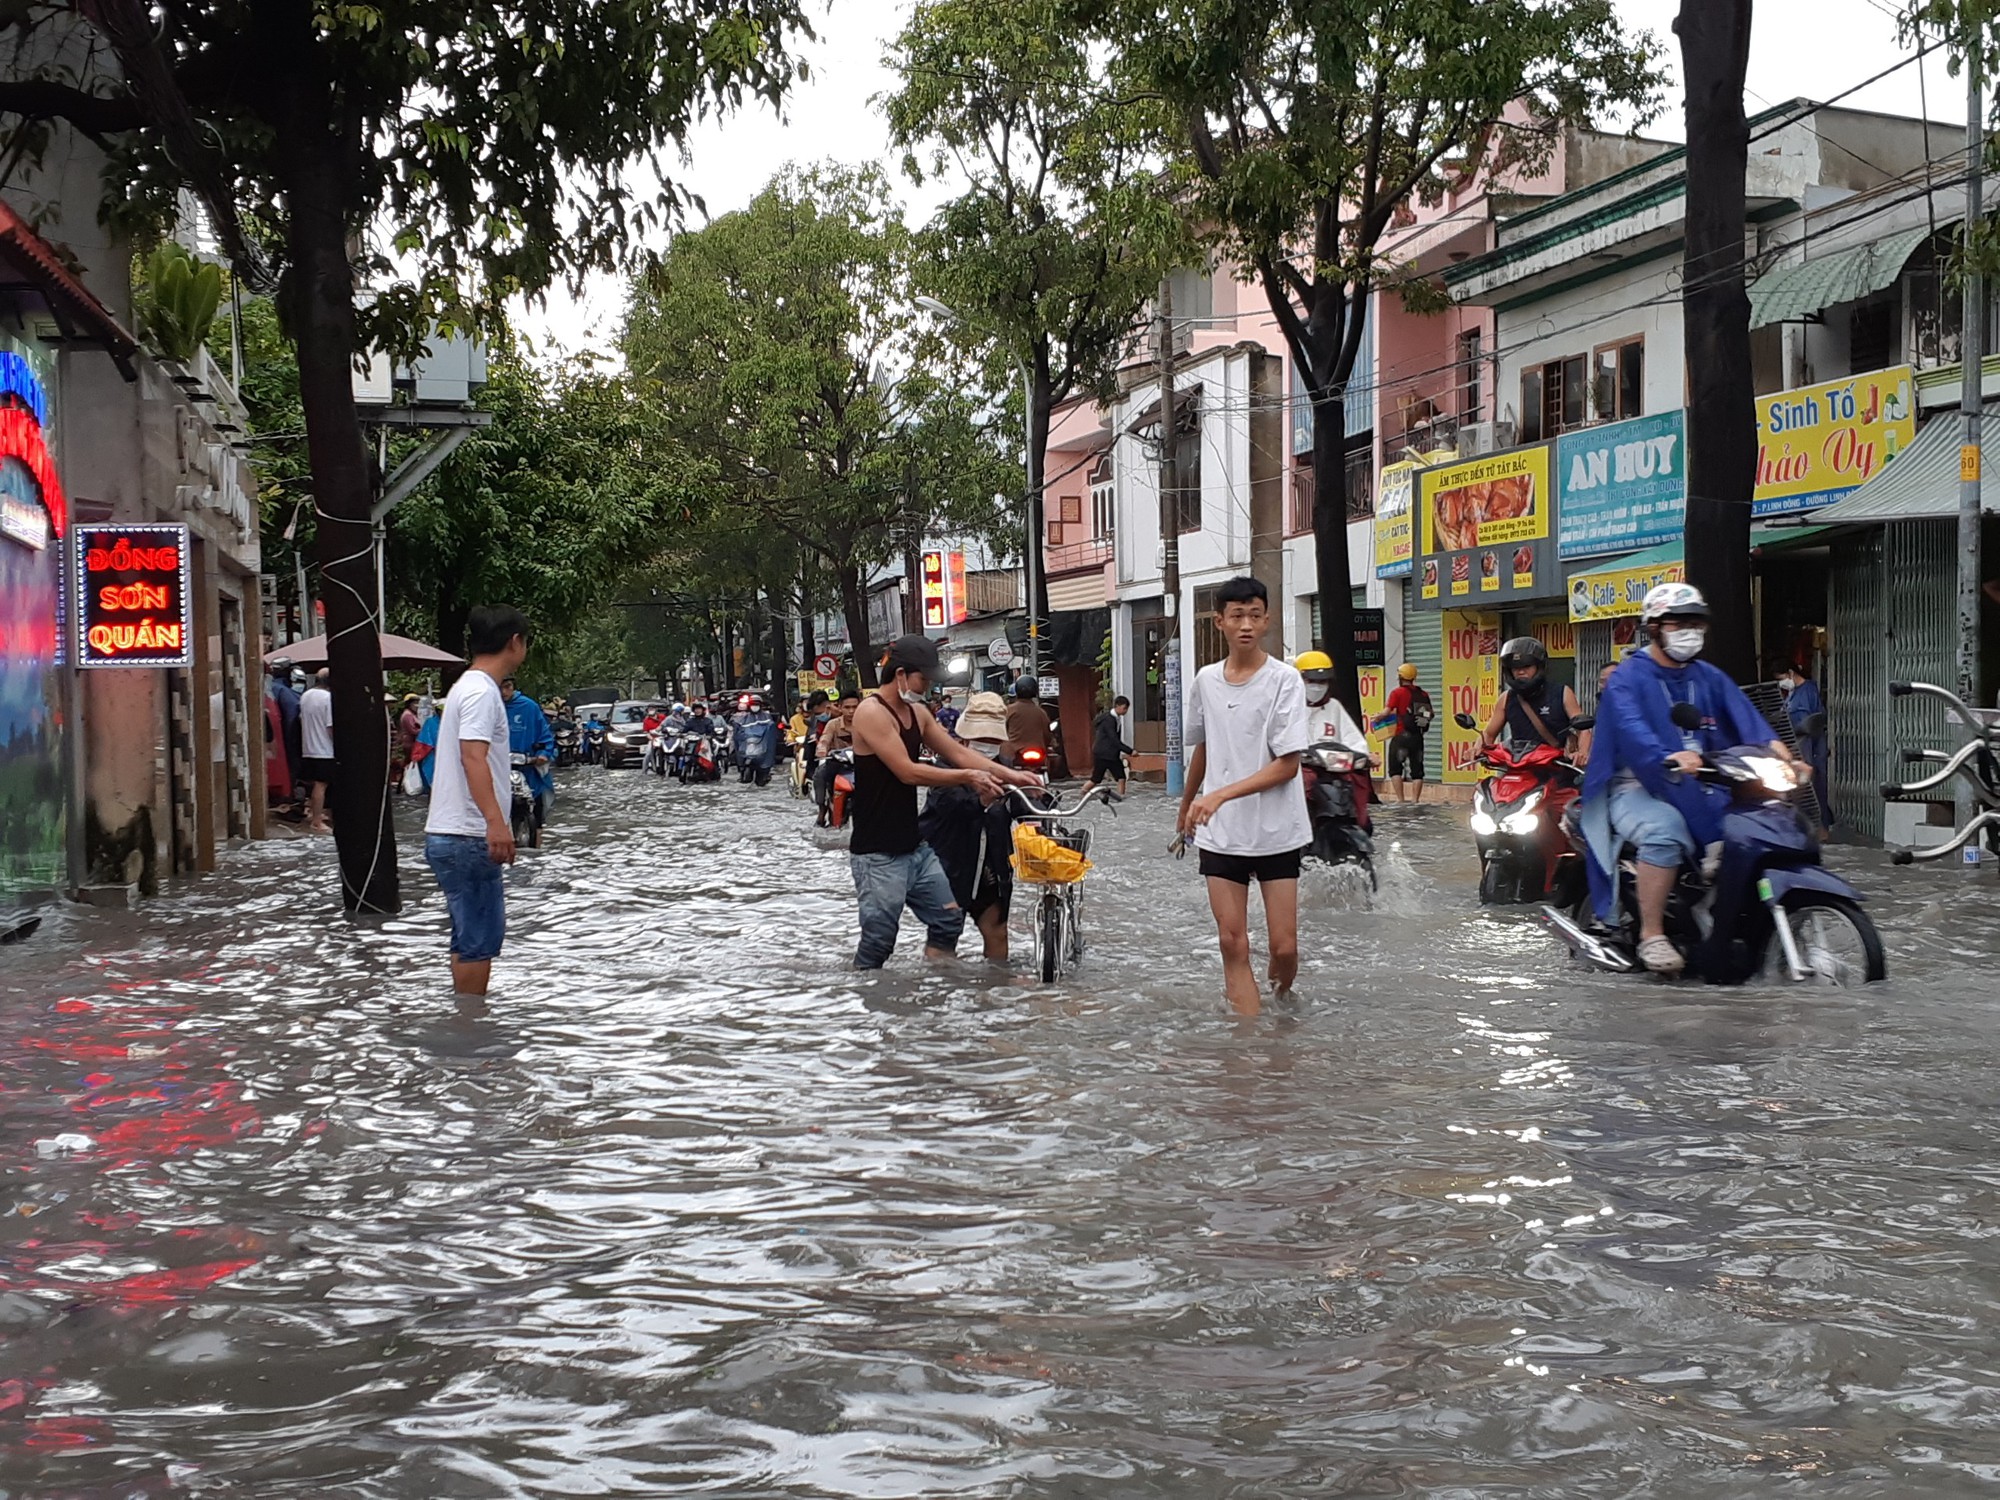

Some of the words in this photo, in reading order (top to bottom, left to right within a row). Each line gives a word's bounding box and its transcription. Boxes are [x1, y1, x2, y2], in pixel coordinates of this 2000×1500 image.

[1769, 395, 1819, 433] Sinh
[1825, 382, 1856, 422] Tố
[1567, 448, 1609, 492] AN
[1613, 433, 1677, 482] HUY
[1755, 442, 1811, 486] hảo
[1822, 427, 1877, 480] Vy
[99, 582, 168, 611] SƠN
[88, 618, 179, 655] QUÁN
[1449, 622, 1478, 661] HỚ
[1551, 622, 1575, 652] QUA
[1360, 670, 1378, 698] ỚT
[1449, 677, 1478, 717] TÓ
[1481, 678, 1495, 697] HEO
[1448, 741, 1478, 772] NA
